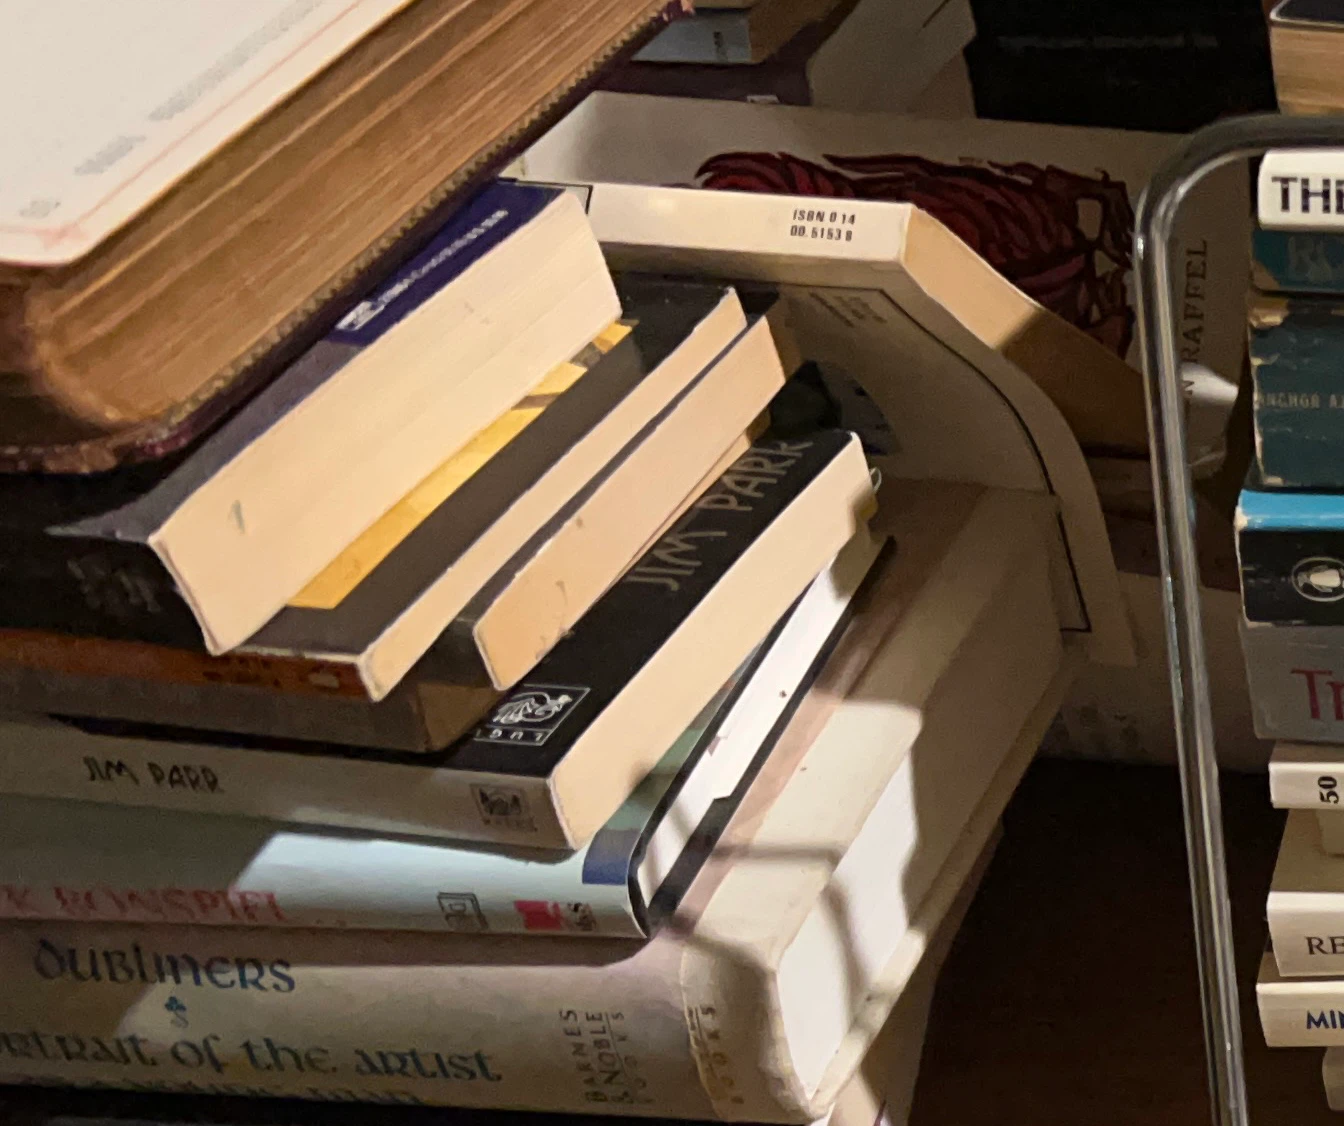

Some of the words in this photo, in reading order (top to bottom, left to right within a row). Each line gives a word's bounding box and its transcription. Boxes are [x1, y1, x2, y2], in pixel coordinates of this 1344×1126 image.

[793, 208, 825, 224] ISBN
[1180, 239, 1208, 364] RAFFEL
[1317, 776, 1342, 804] 50
[170, 1035, 225, 1074] of
[240, 1036, 338, 1073] the
[355, 1047, 503, 1083] artist
